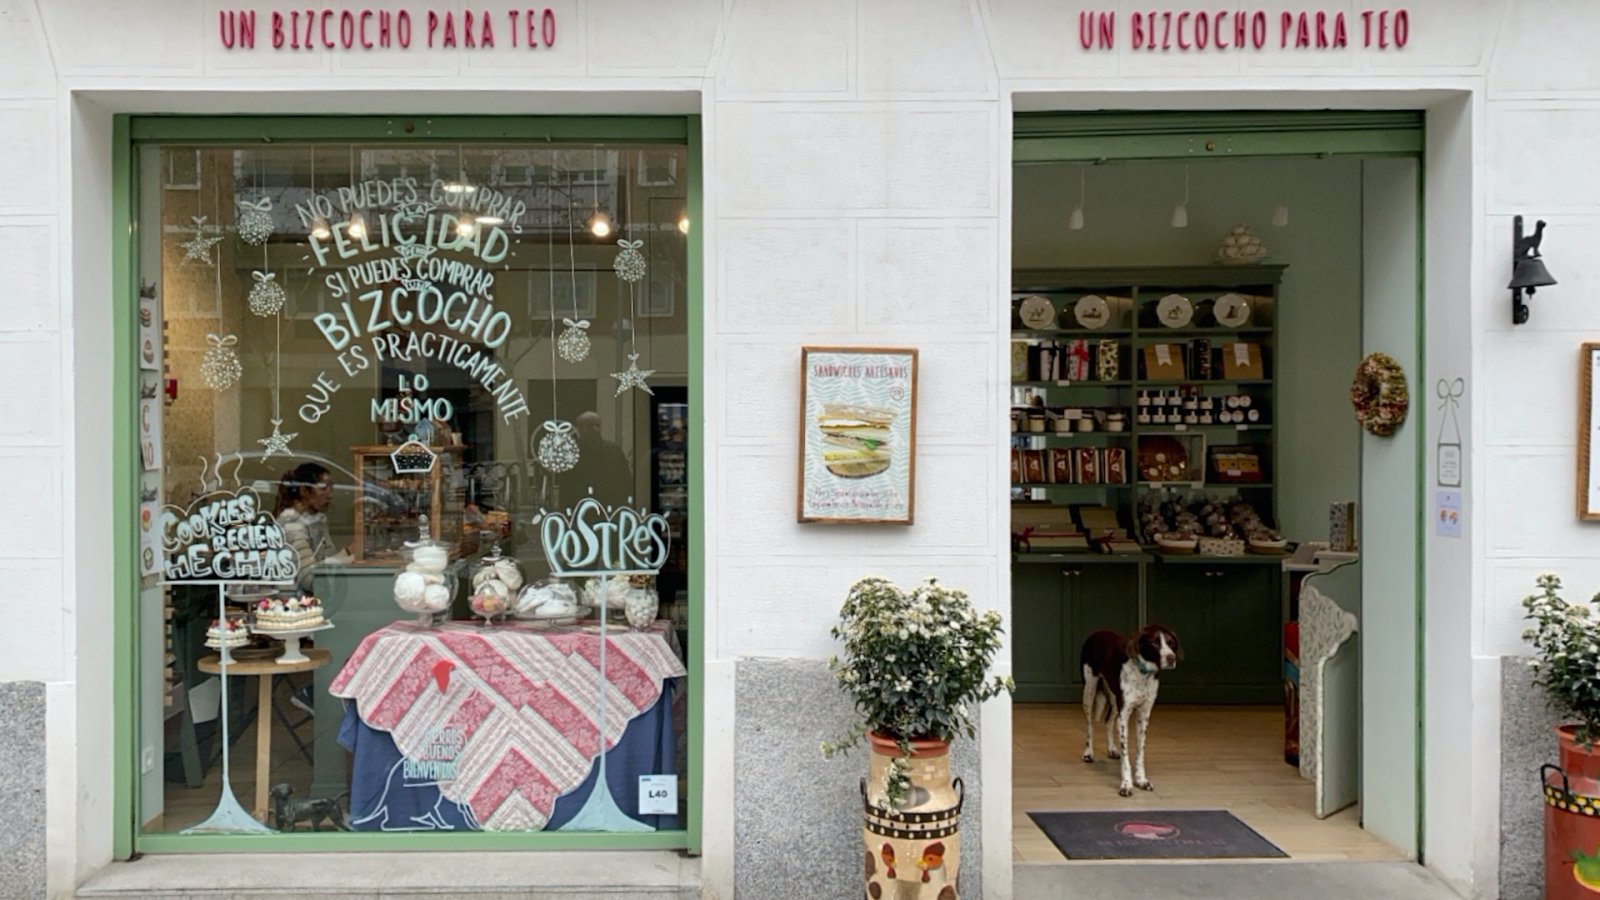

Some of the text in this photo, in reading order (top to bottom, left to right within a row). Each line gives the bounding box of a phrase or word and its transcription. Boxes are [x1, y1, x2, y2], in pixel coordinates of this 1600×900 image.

[219, 9, 555, 49] UN BIZCOCHO PARA TEO
[1080, 10, 1409, 49] UN BIZCOCHO PARA TEO
[295, 177, 526, 233] NO PUEDES COMPRAR
[309, 213, 509, 266] FELICIDAD
[325, 257, 494, 300] SI PUEDES COMPRAR
[314, 285, 512, 351] BIZCOCHO
[298, 331, 531, 426] QUE ES PRACTICAMENTE
[398, 374, 430, 392] LO
[371, 397, 453, 423] MISMO
[212, 516, 283, 552] RECIÉN
[164, 544, 296, 579] HECHAS
[648, 790, 668, 798] L40
